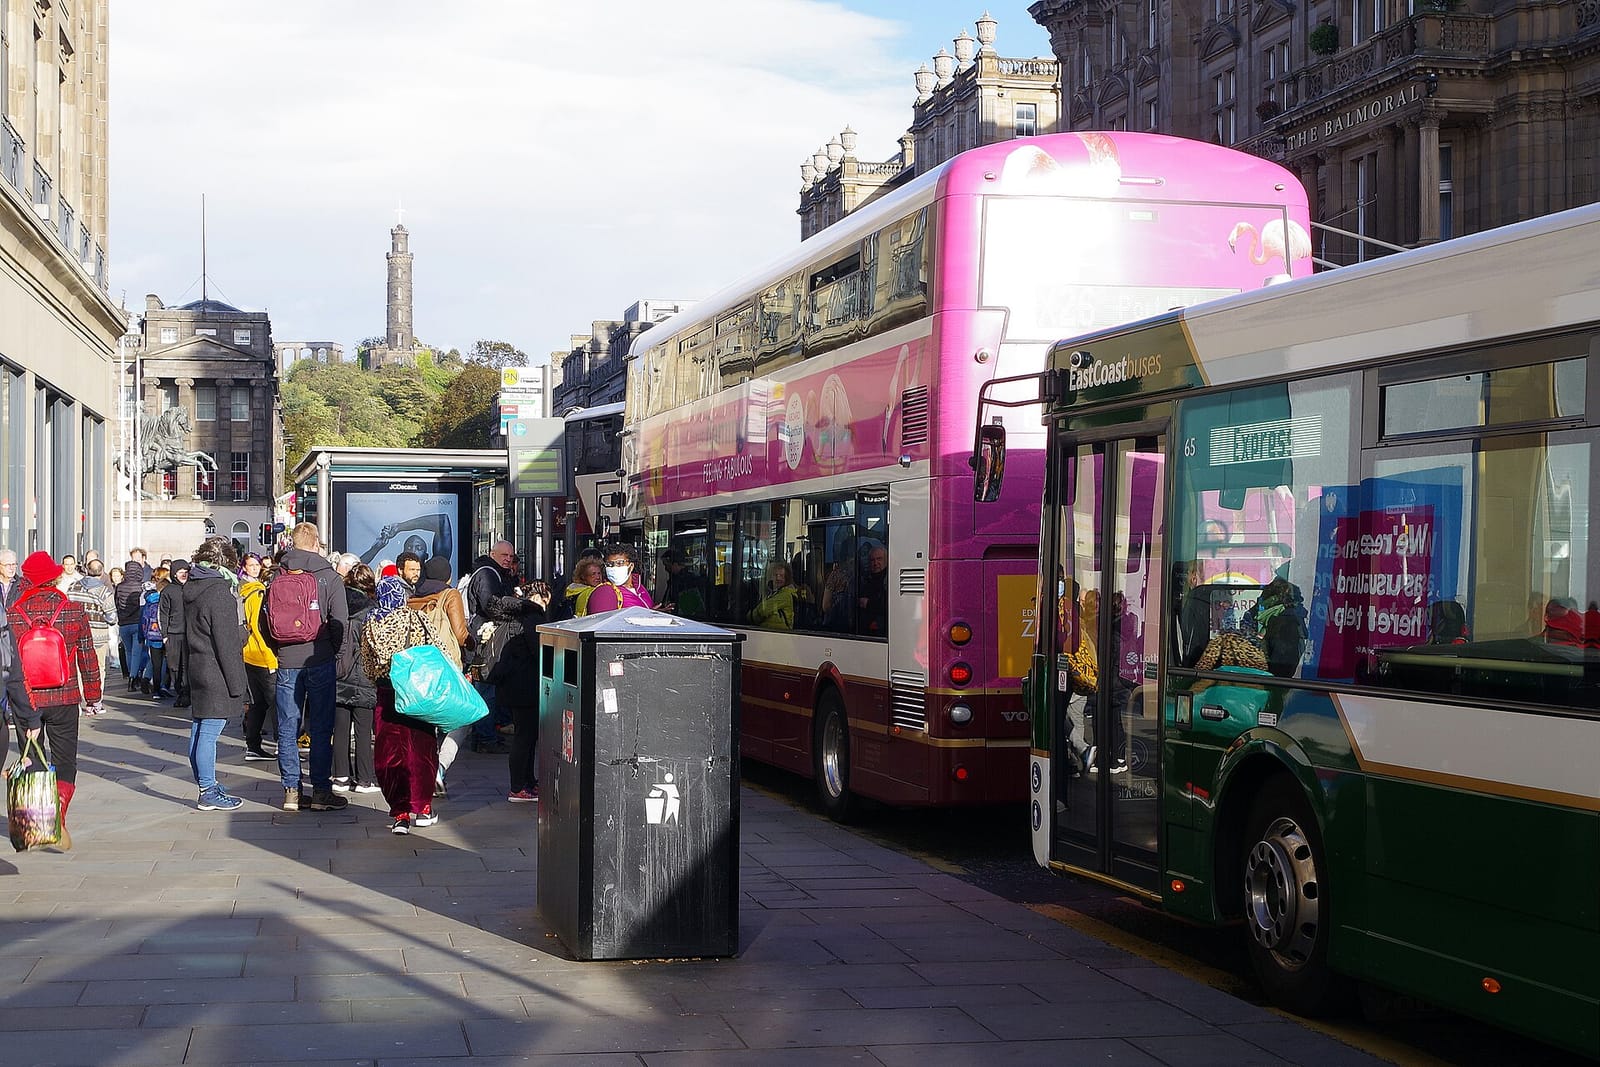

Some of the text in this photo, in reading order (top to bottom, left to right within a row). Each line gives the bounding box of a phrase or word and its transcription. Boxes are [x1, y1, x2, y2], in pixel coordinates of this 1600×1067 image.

[1287, 86, 1420, 150] THE BALMORAL
[1184, 438, 1196, 456] 65
[703, 454, 753, 484] FEELING FABULOUS
[1022, 609, 1036, 617] EDI
[1021, 619, 1035, 637] Z
[1001, 711, 1031, 722] VO
